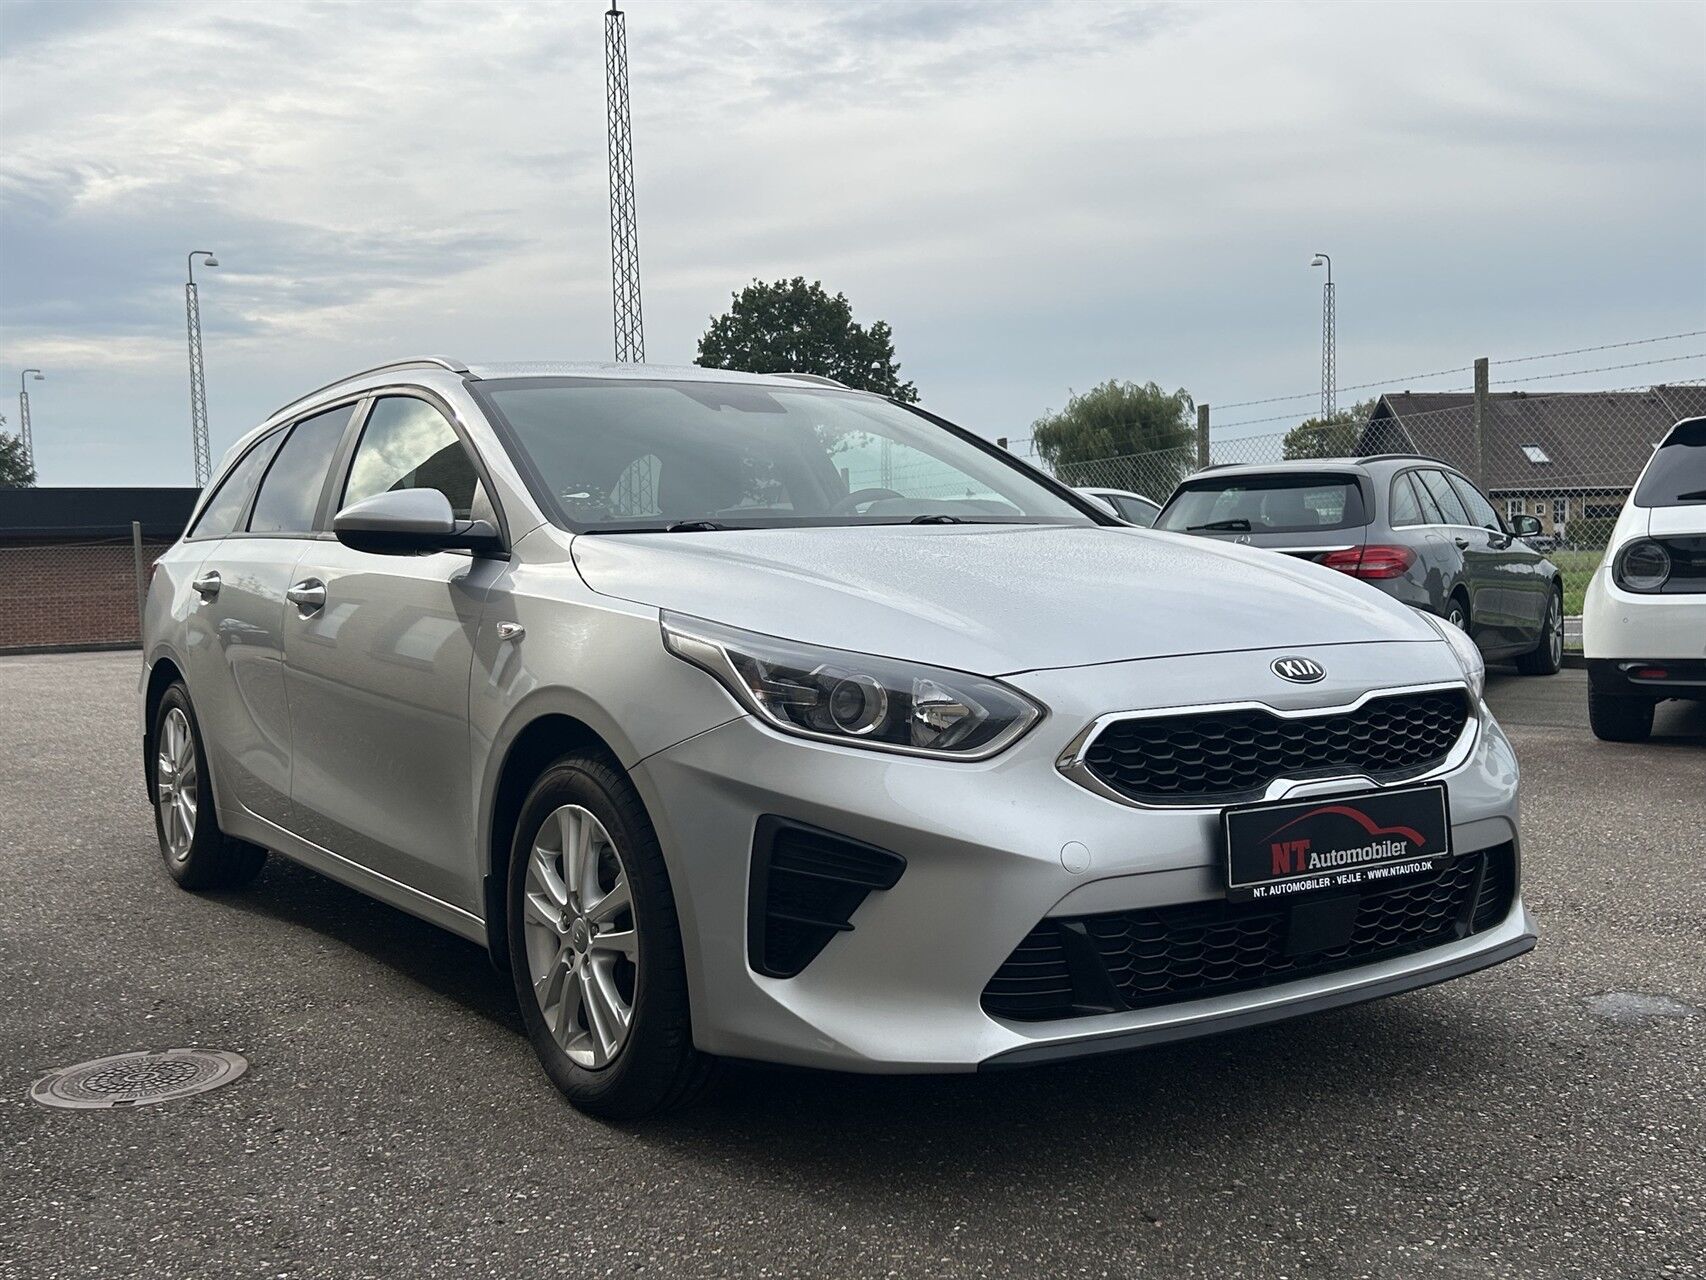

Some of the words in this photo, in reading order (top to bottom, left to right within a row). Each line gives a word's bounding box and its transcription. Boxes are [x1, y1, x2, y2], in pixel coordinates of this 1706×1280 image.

[1278, 659, 1322, 677] KIA
[1271, 839, 1311, 875] NT
[1308, 840, 1407, 870] Automobiler
[1253, 887, 1268, 898] NT.
[1269, 877, 1331, 896] AUTOMOBILER
[1336, 872, 1362, 885] VEJLE
[1367, 860, 1433, 880] WWW.NTAUTO.DK
